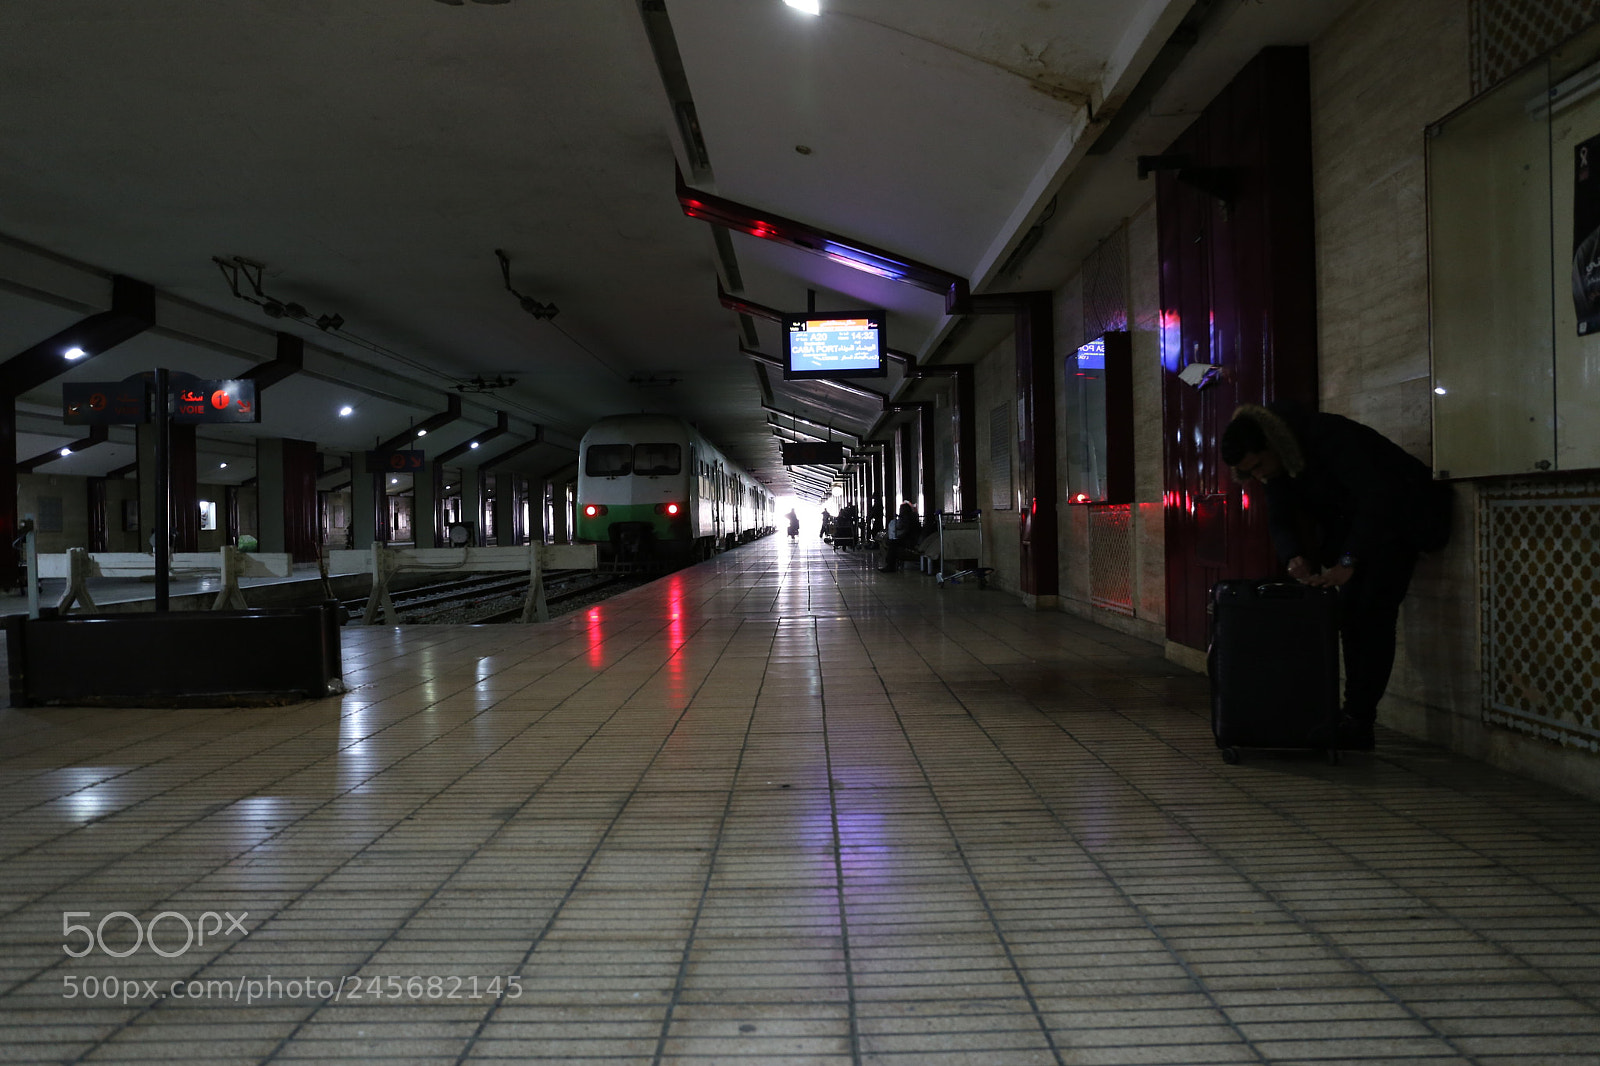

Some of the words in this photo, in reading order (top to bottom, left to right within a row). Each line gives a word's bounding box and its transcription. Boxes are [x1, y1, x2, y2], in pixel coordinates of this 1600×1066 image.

[792, 346, 814, 354] CASA
[816, 344, 838, 353] PORT
[180, 406, 204, 414] VOIE
